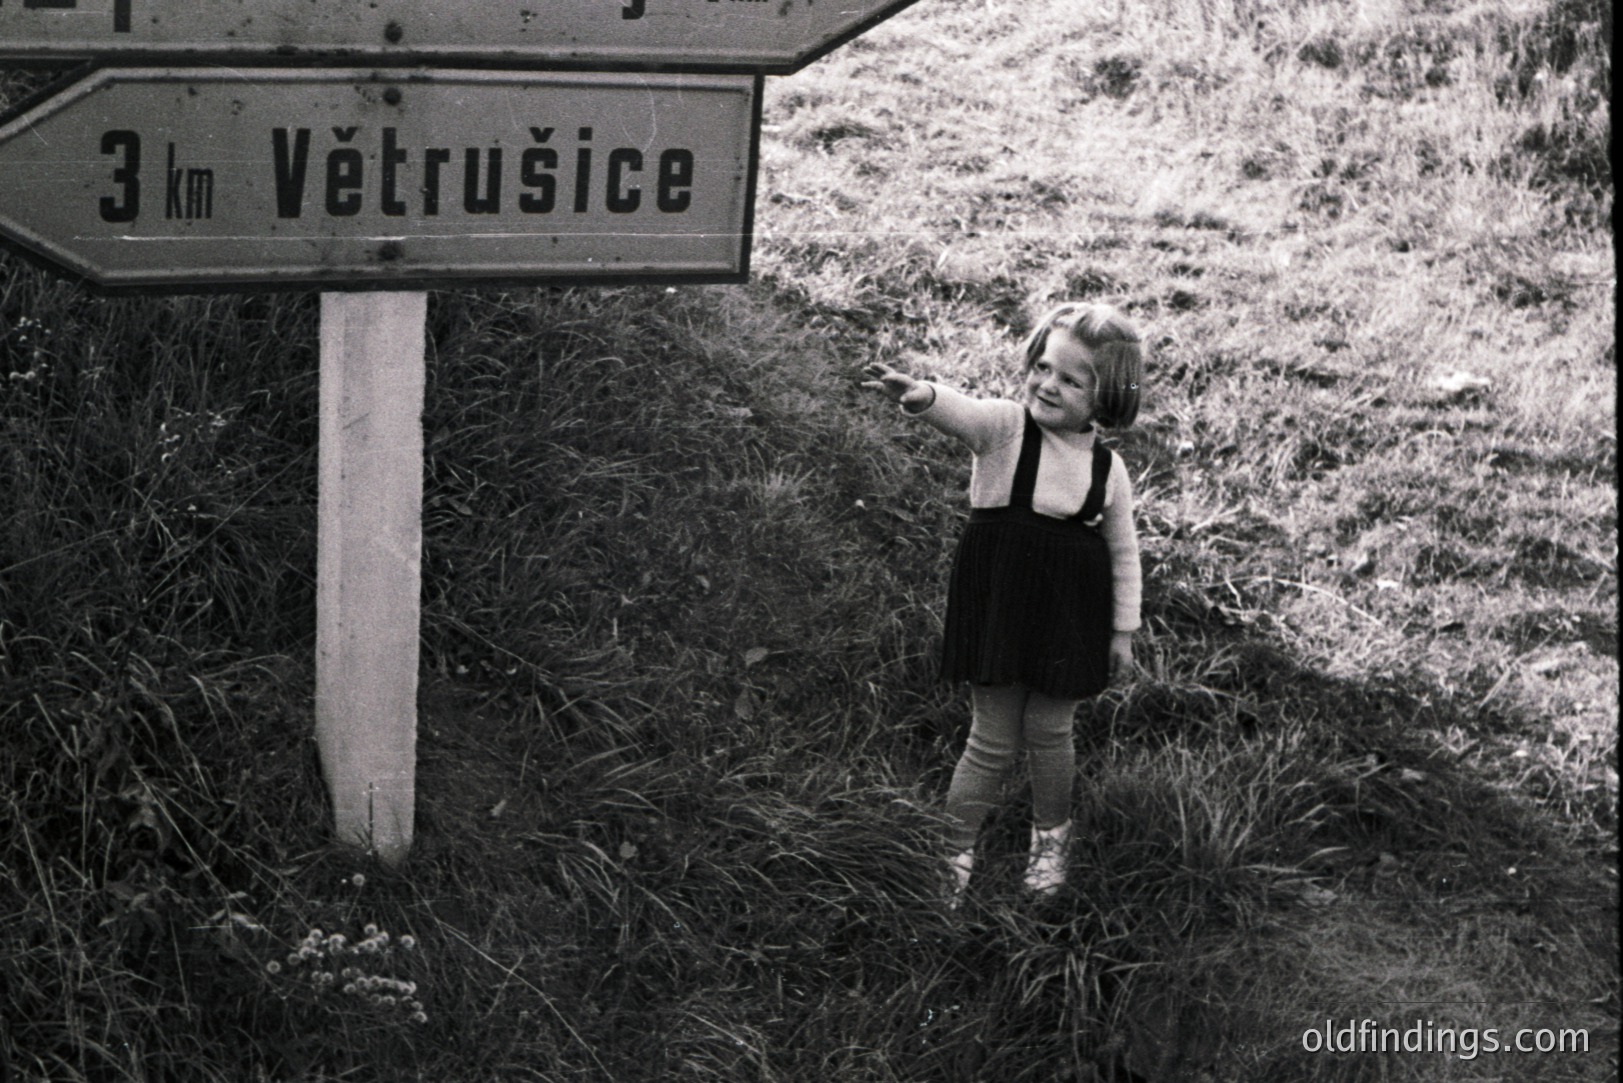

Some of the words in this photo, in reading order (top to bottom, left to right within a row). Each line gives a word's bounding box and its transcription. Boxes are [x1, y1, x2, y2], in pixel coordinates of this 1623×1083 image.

[100, 130, 141, 223] 3
[166, 142, 214, 220] km
[272, 126, 695, 219] Větrušice
